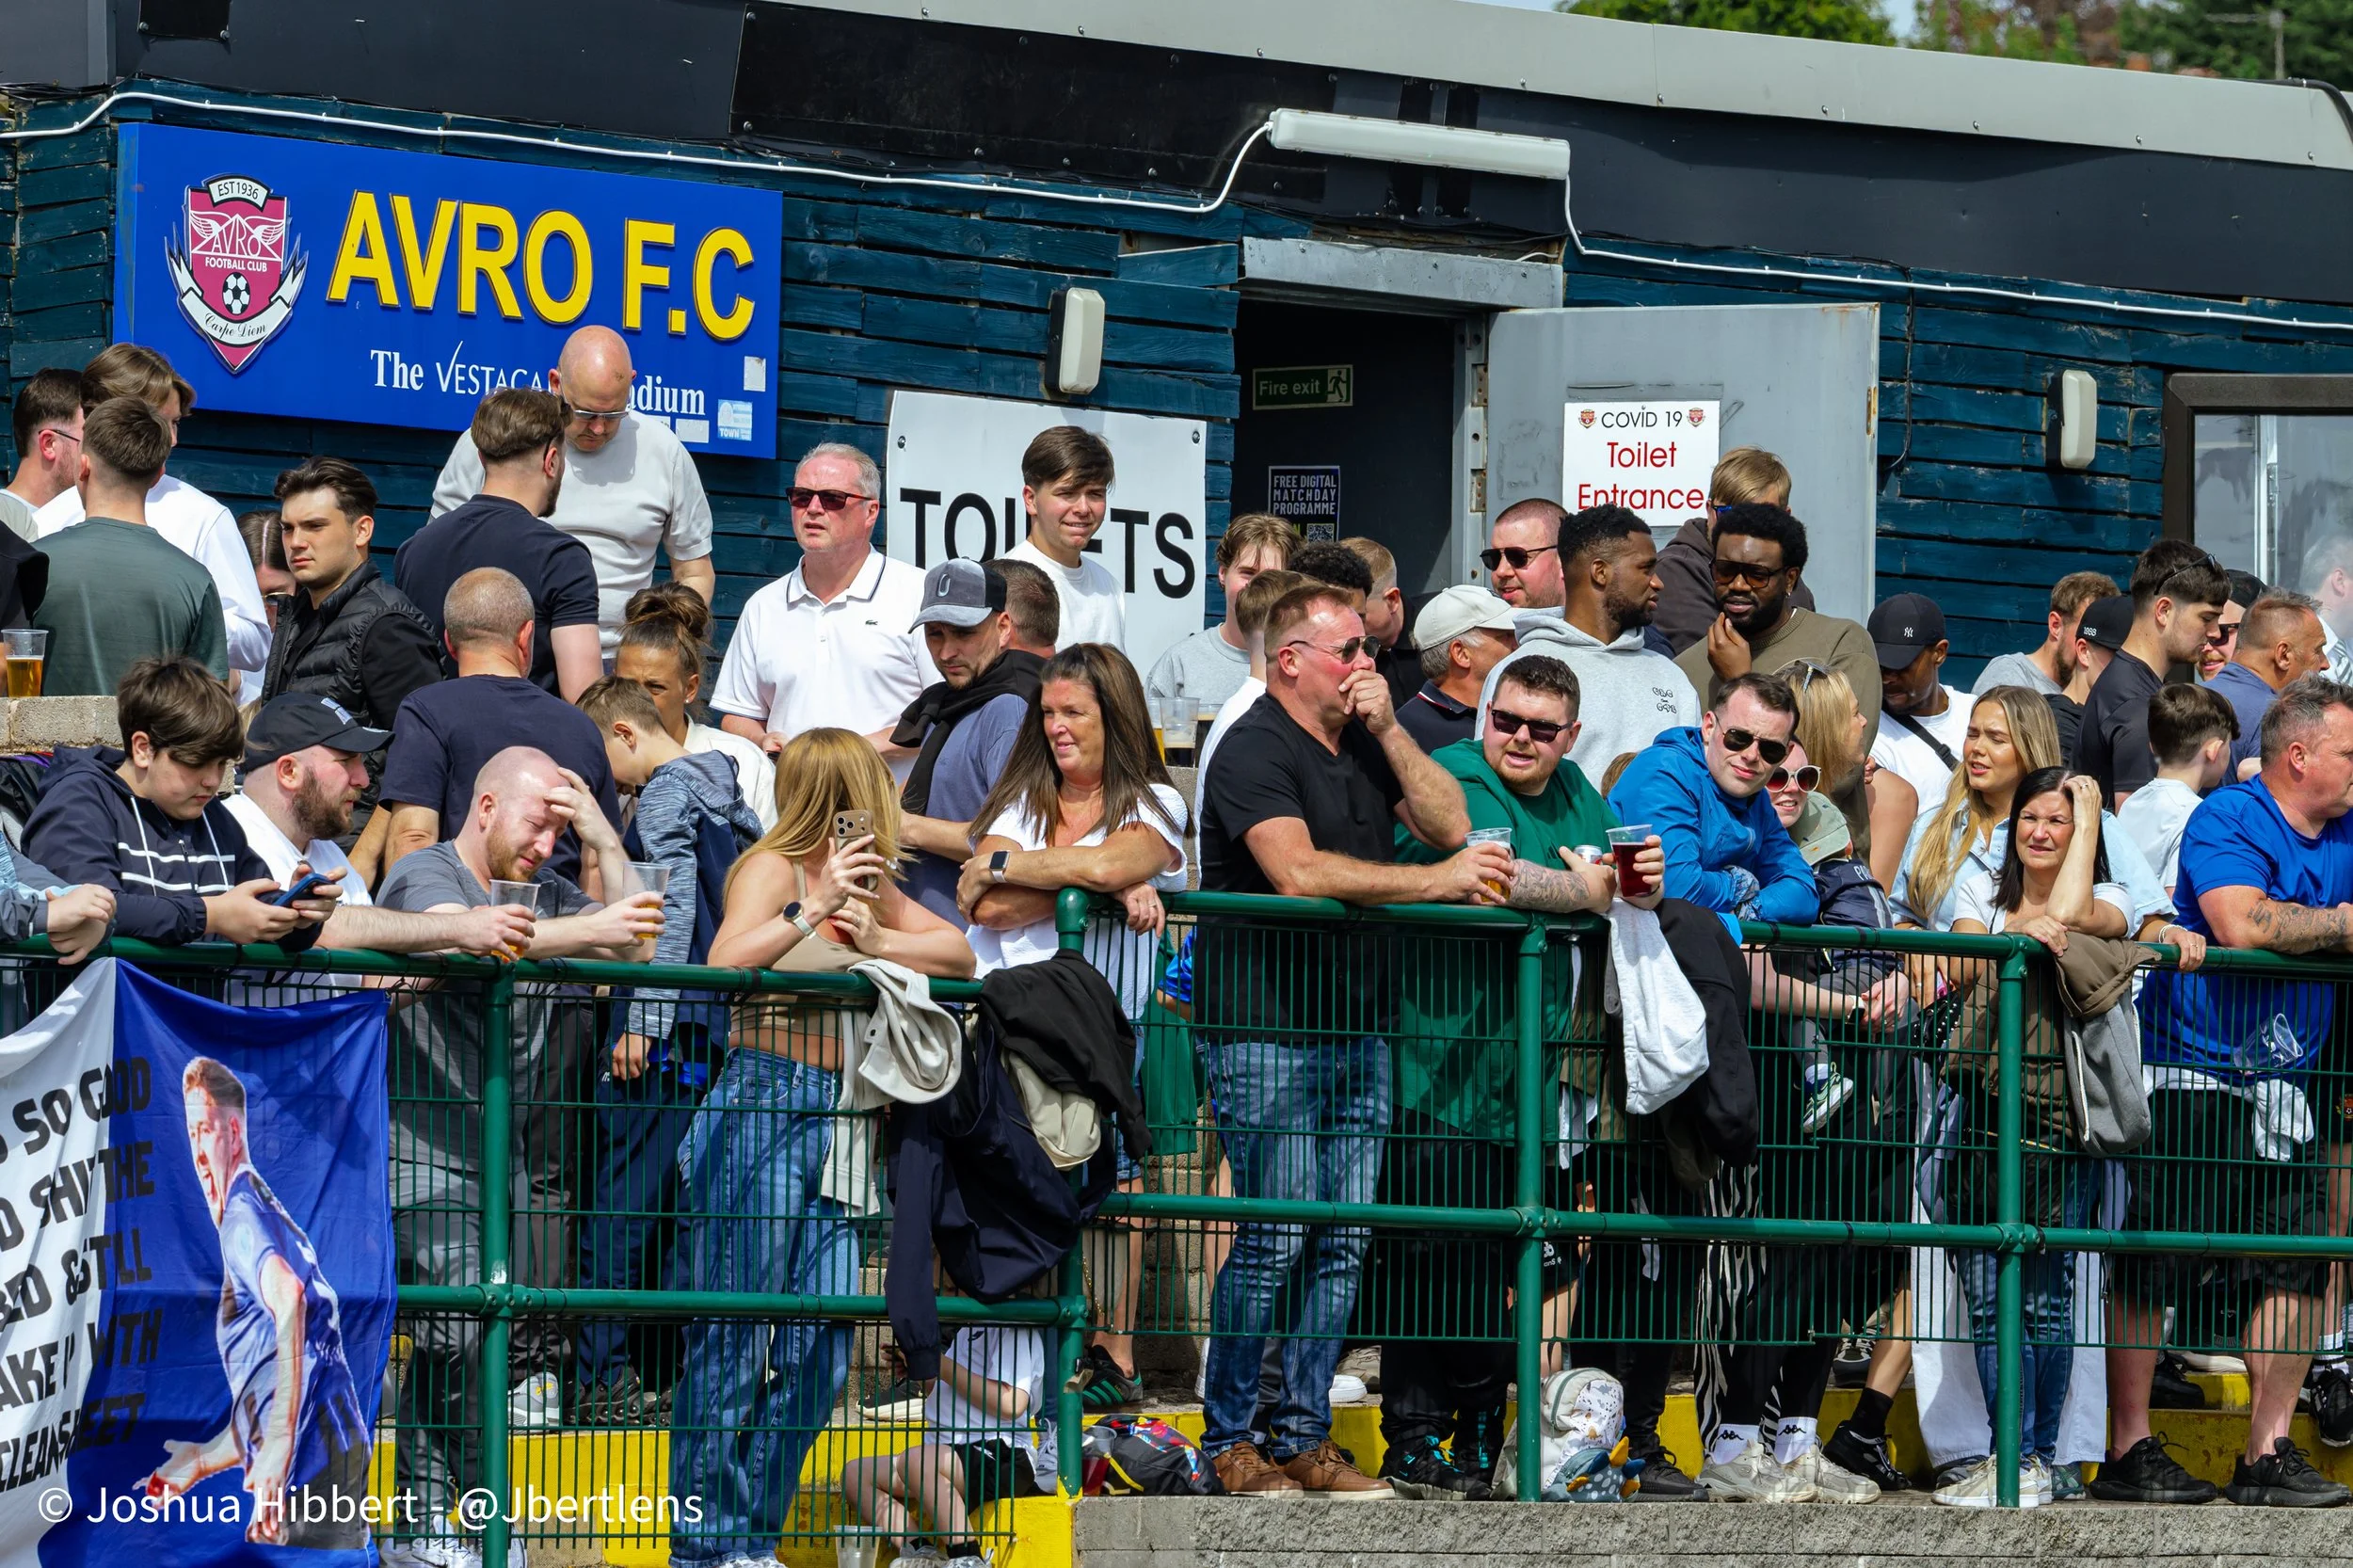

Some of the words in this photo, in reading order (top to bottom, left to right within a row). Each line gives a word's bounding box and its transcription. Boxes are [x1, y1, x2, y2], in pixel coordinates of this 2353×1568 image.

[217, 182, 234, 197] EST
[236, 183, 259, 200] 1936
[212, 216, 261, 257] AVRO
[205, 257, 246, 270] FOOTBALL
[248, 261, 268, 272] CLUB
[326, 189, 594, 325] AVRO
[622, 217, 755, 341] F.C
[204, 312, 234, 340] Carpe
[237, 323, 267, 338] Diem
[370, 349, 424, 391] The
[436, 341, 551, 395] VESTACA
[1259, 380, 1289, 396] Fire
[1293, 379, 1321, 395] exit
[1601, 410, 1657, 428] COVID
[1666, 410, 1683, 427] 19
[1607, 441, 1677, 468] Toilet
[1273, 475, 1298, 488] FREE
[1301, 475, 1337, 488] DIGITAL
[1273, 488, 1337, 502] MATCHDAY
[1578, 484, 1705, 510] Entrance
[1273, 502, 1336, 515] PROGRAMME
[900, 488, 1195, 599] TOITS
[12, 1088, 72, 1156] SO
[98, 1140, 155, 1203] THE
